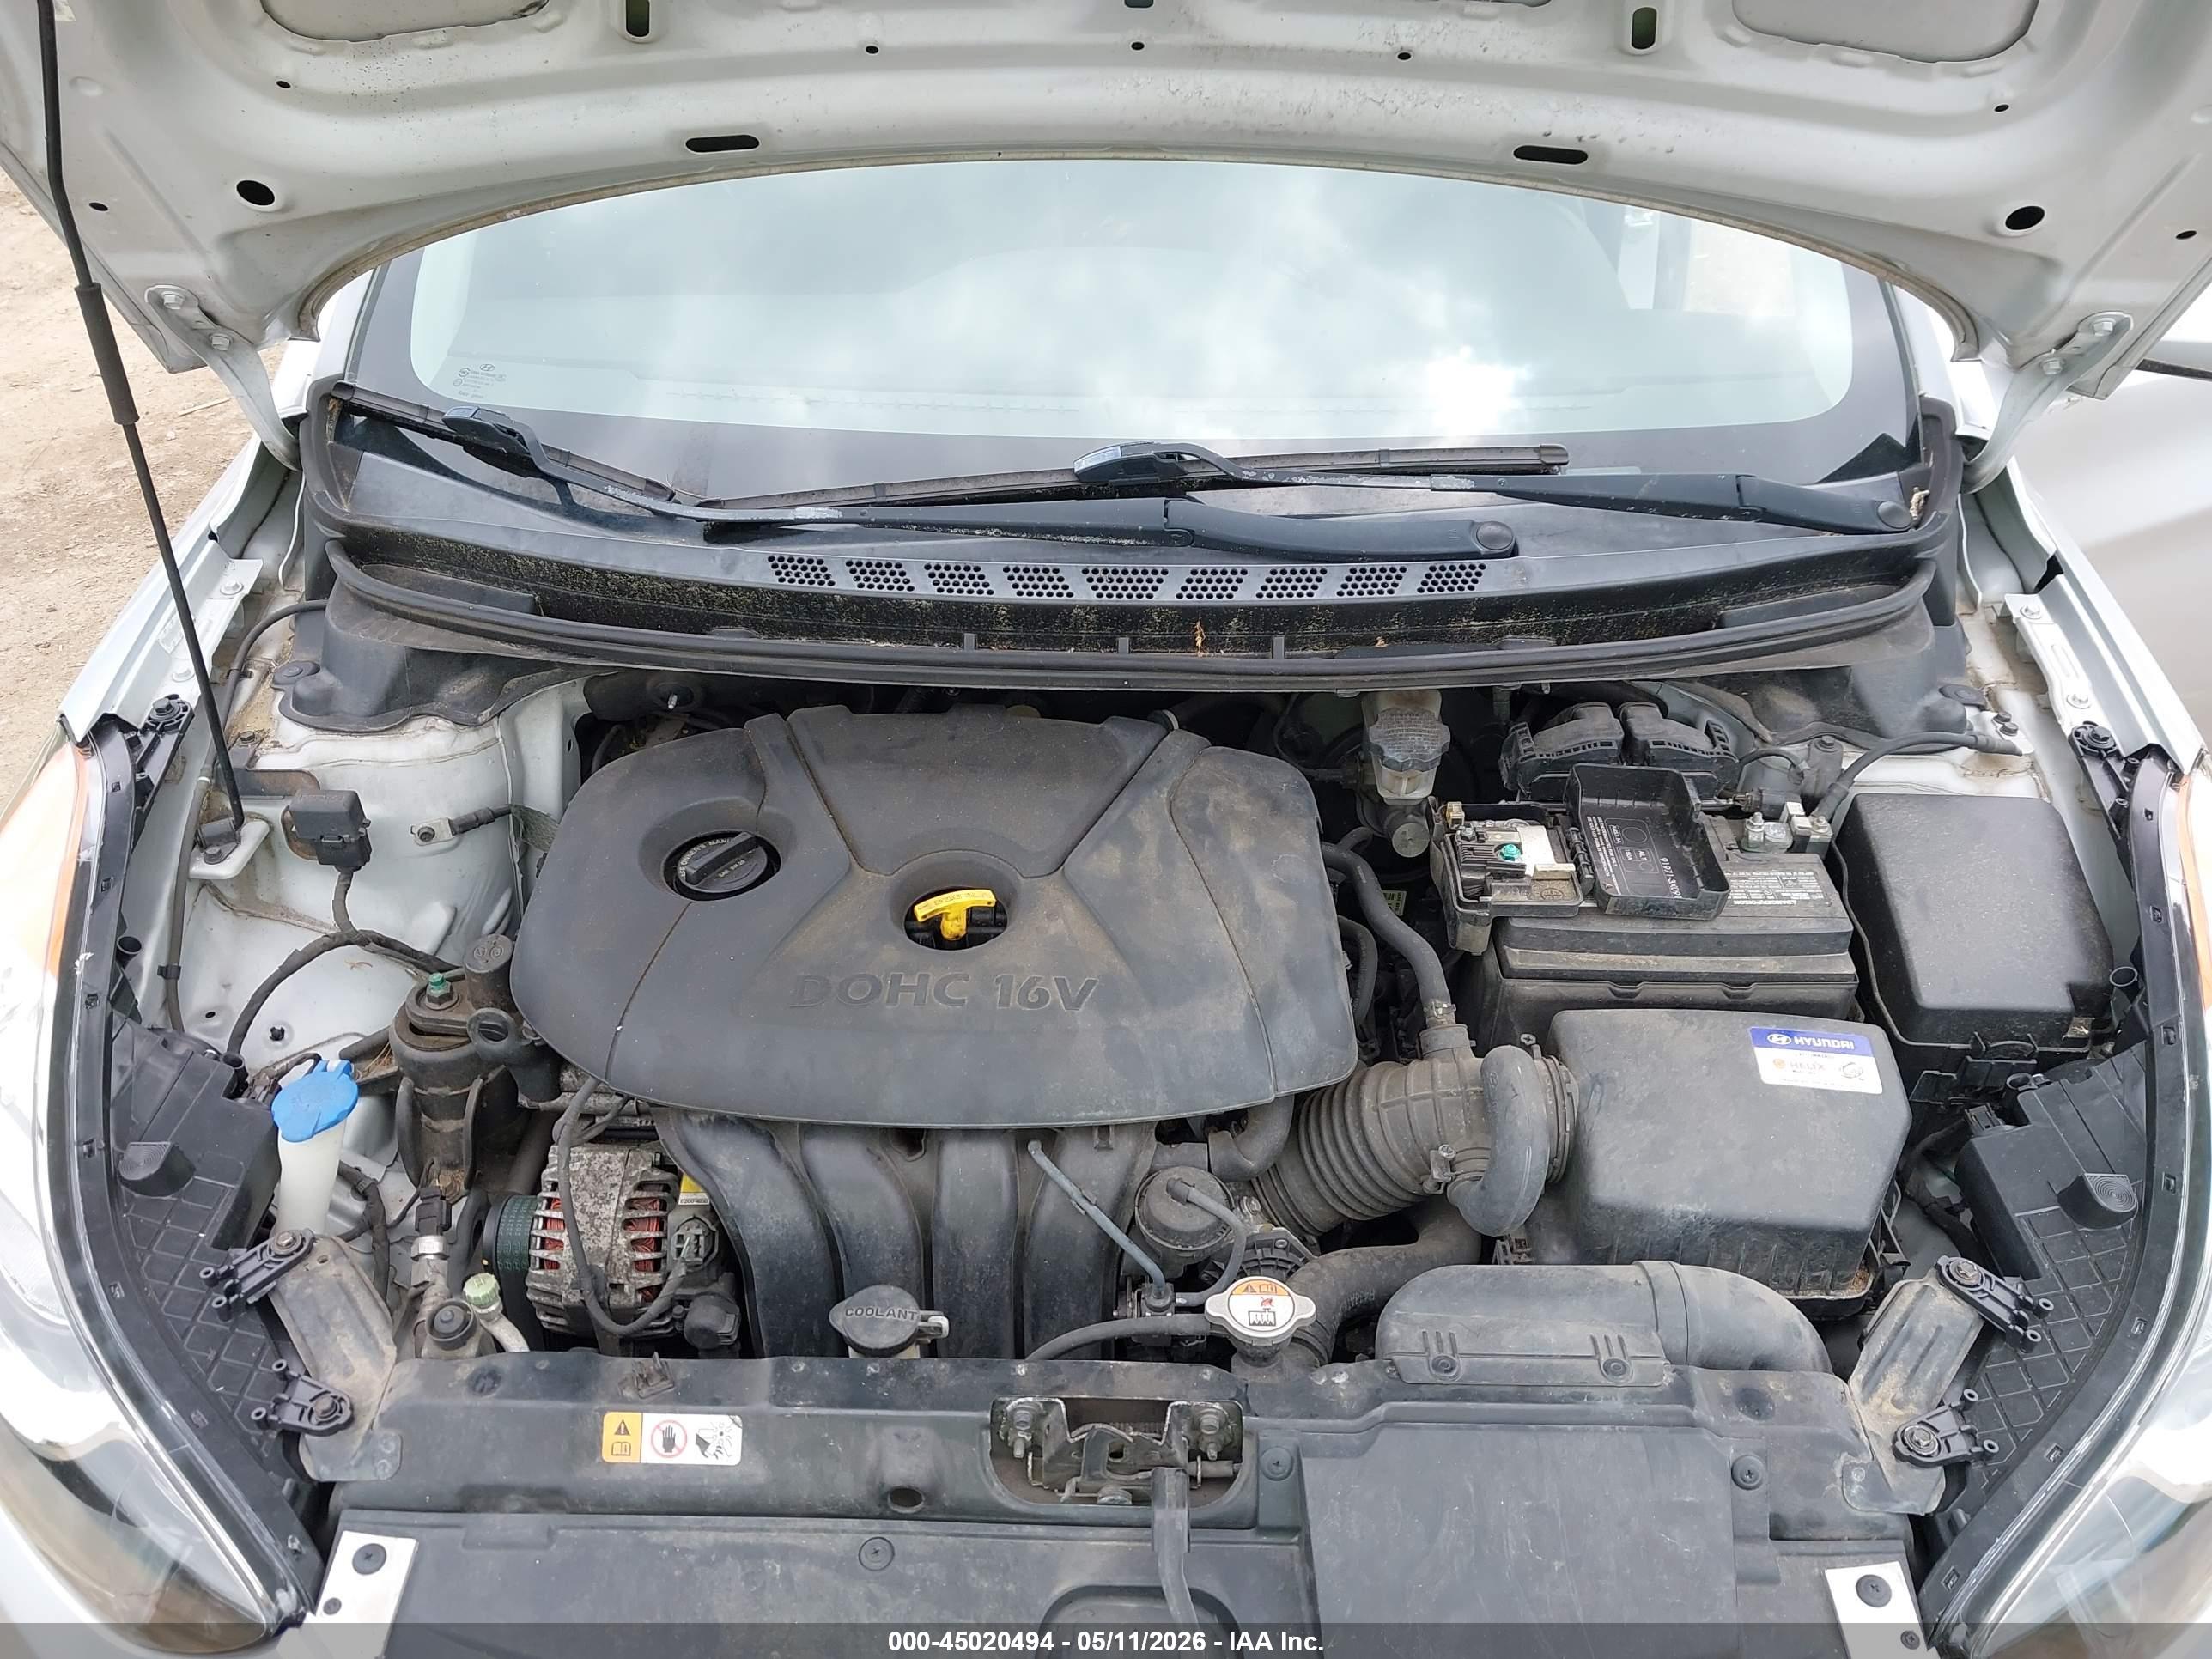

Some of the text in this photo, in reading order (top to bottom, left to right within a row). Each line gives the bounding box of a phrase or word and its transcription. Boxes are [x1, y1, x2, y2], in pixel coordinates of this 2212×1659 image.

[790, 972, 1100, 1012] DOHC 16V
[1793, 1036, 1855, 1050] HYUNDAI
[845, 1306, 919, 1321] COOLANT
